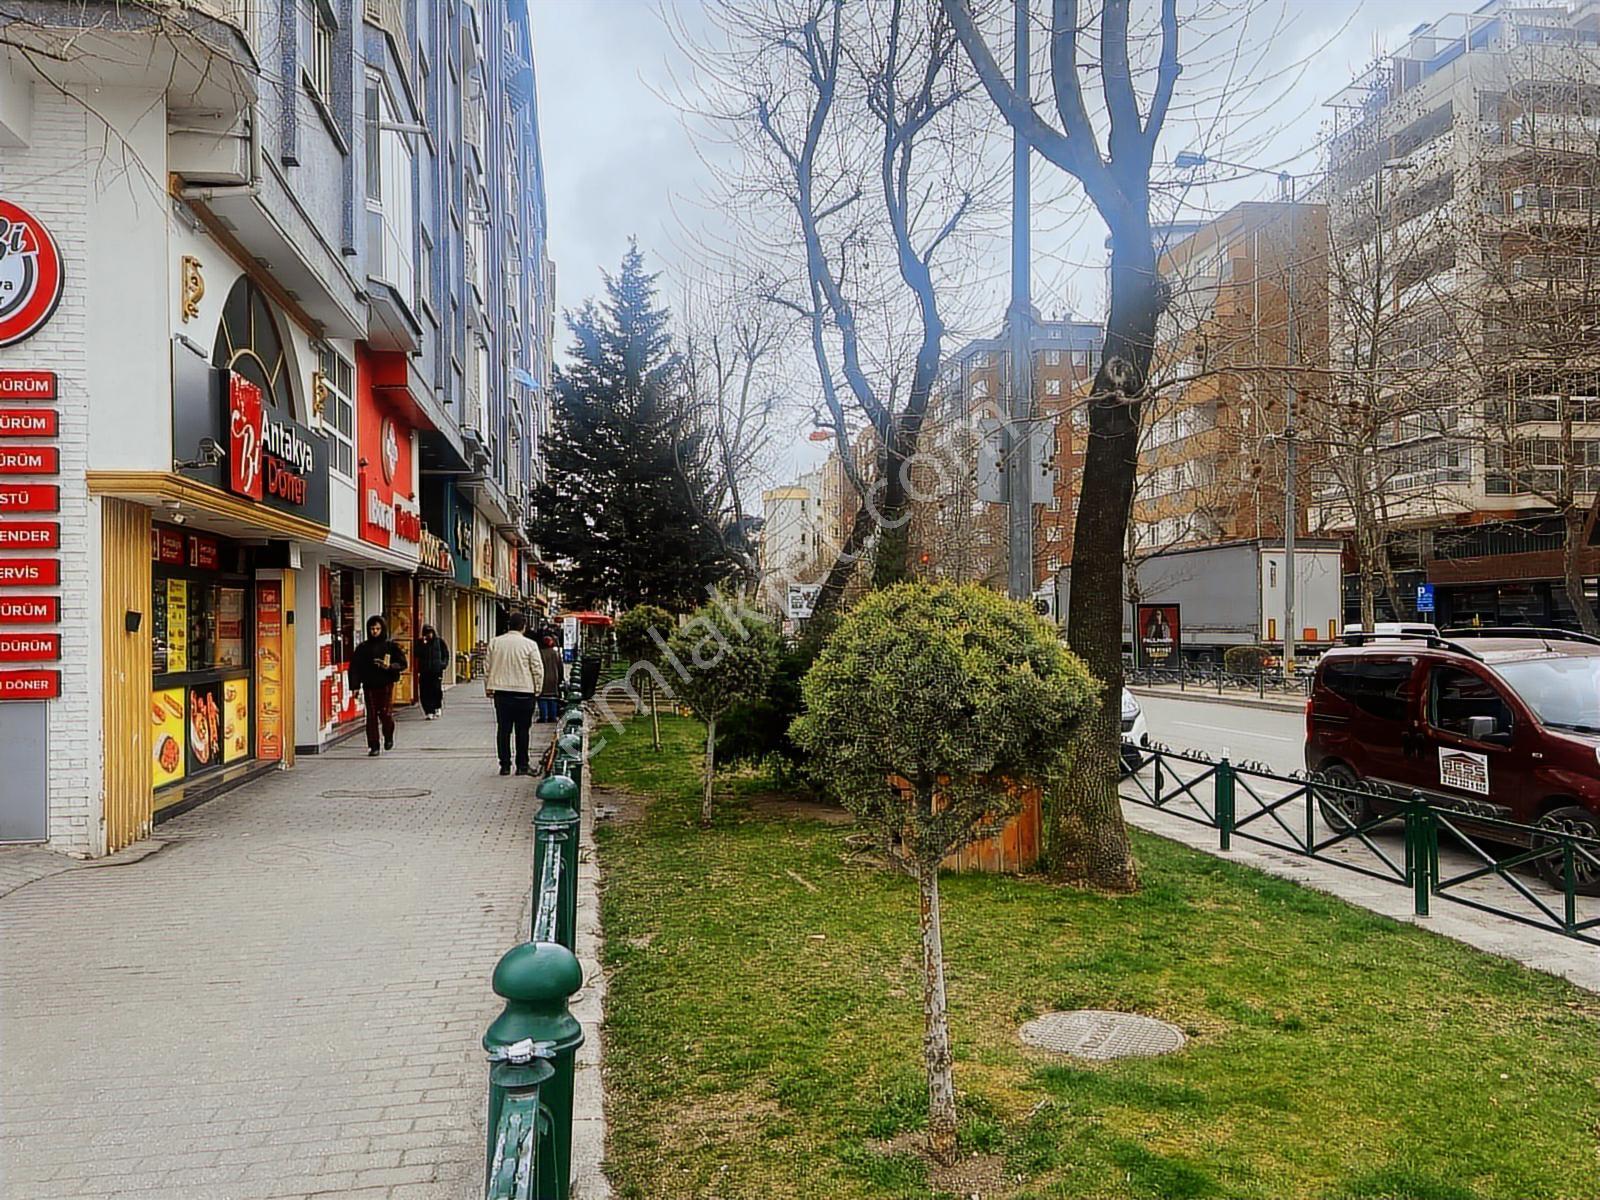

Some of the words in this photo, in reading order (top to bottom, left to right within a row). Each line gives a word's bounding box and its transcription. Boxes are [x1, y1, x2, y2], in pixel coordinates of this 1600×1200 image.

[0, 378, 49, 392] ÜRÜM
[261, 409, 313, 475] Antakya
[267, 456, 308, 506] Döner
[1417, 586, 1426, 598] P
[1, 640, 52, 652] DÜRÜM
[5, 679, 49, 690] DÖNER
